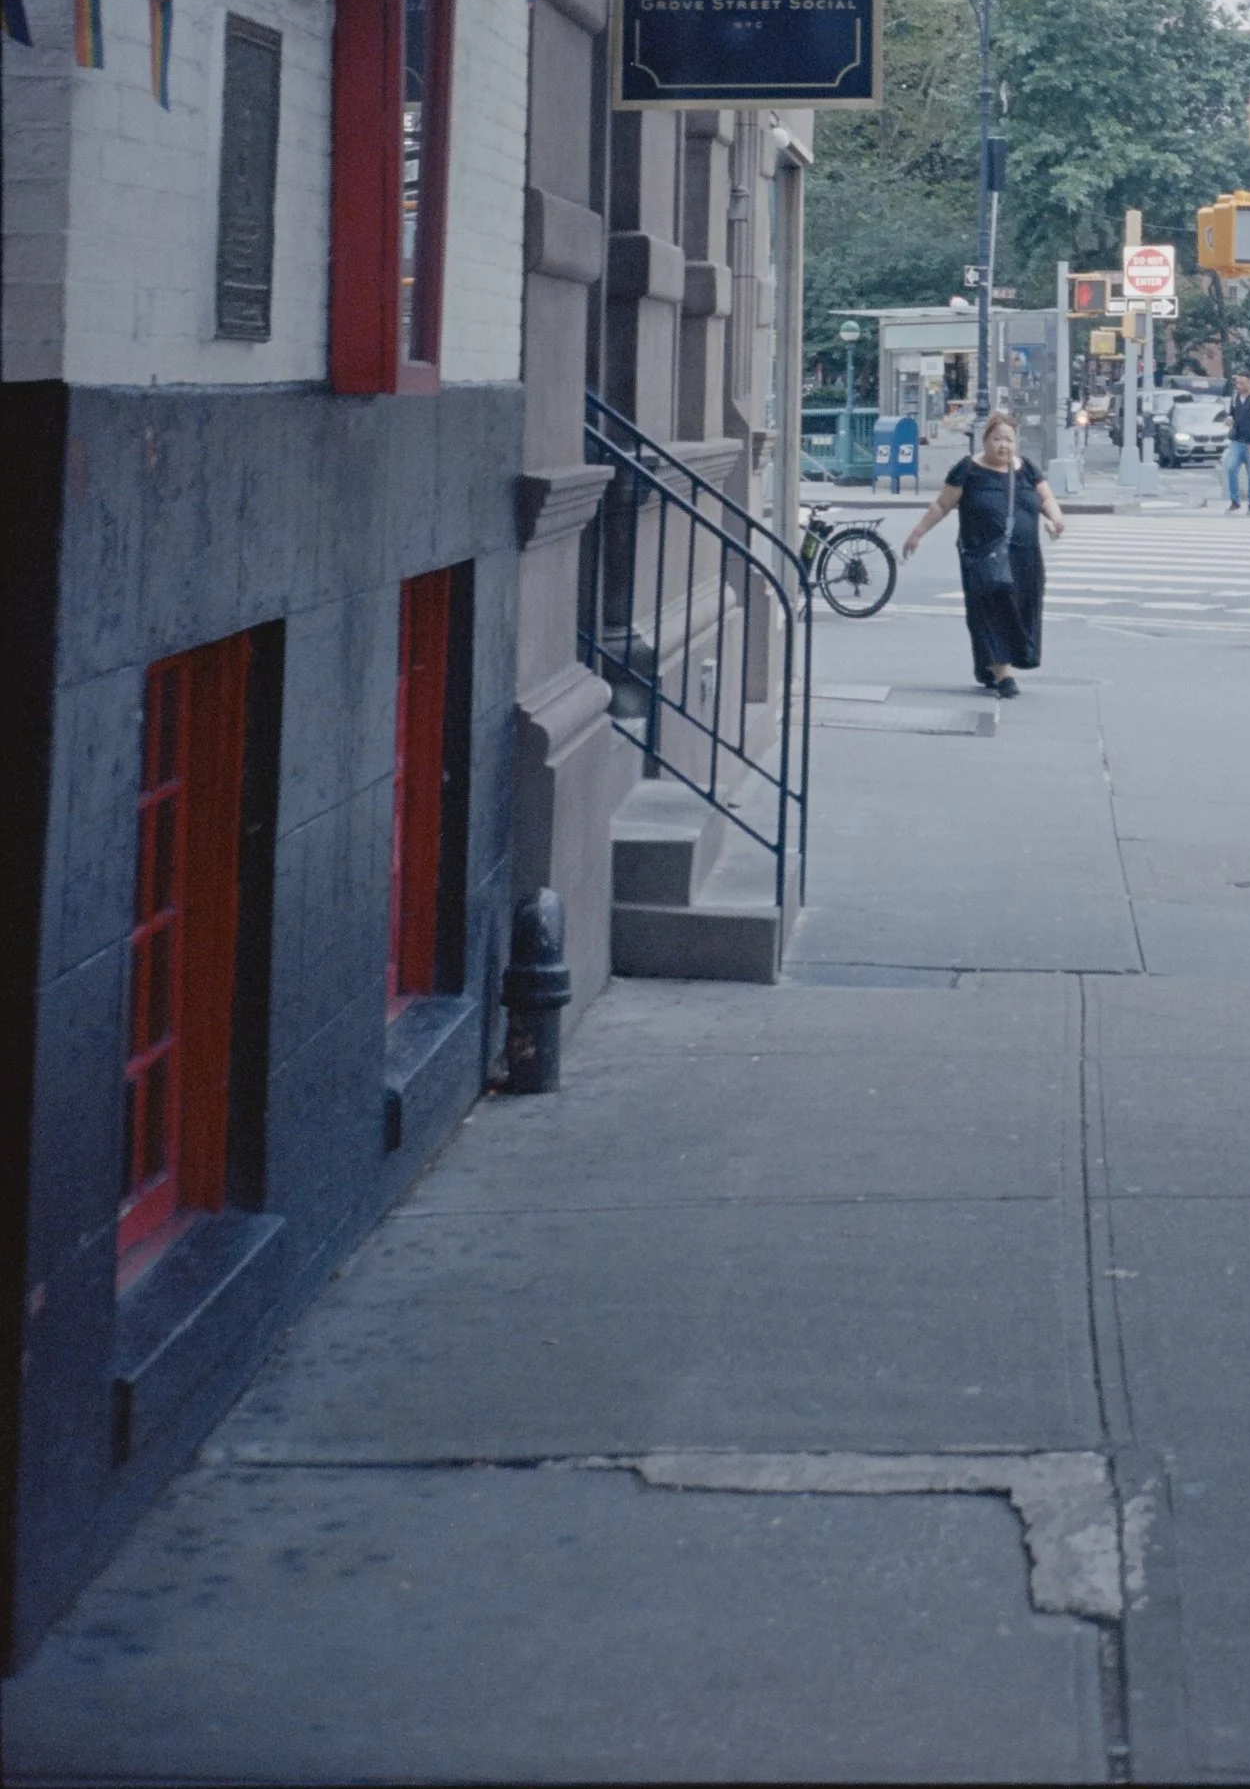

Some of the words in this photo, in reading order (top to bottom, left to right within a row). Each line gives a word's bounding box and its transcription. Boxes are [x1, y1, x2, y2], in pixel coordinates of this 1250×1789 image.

[1133, 256, 1146, 265] DO
[1147, 256, 1164, 265] NOT
[1135, 277, 1163, 287] ENTER
